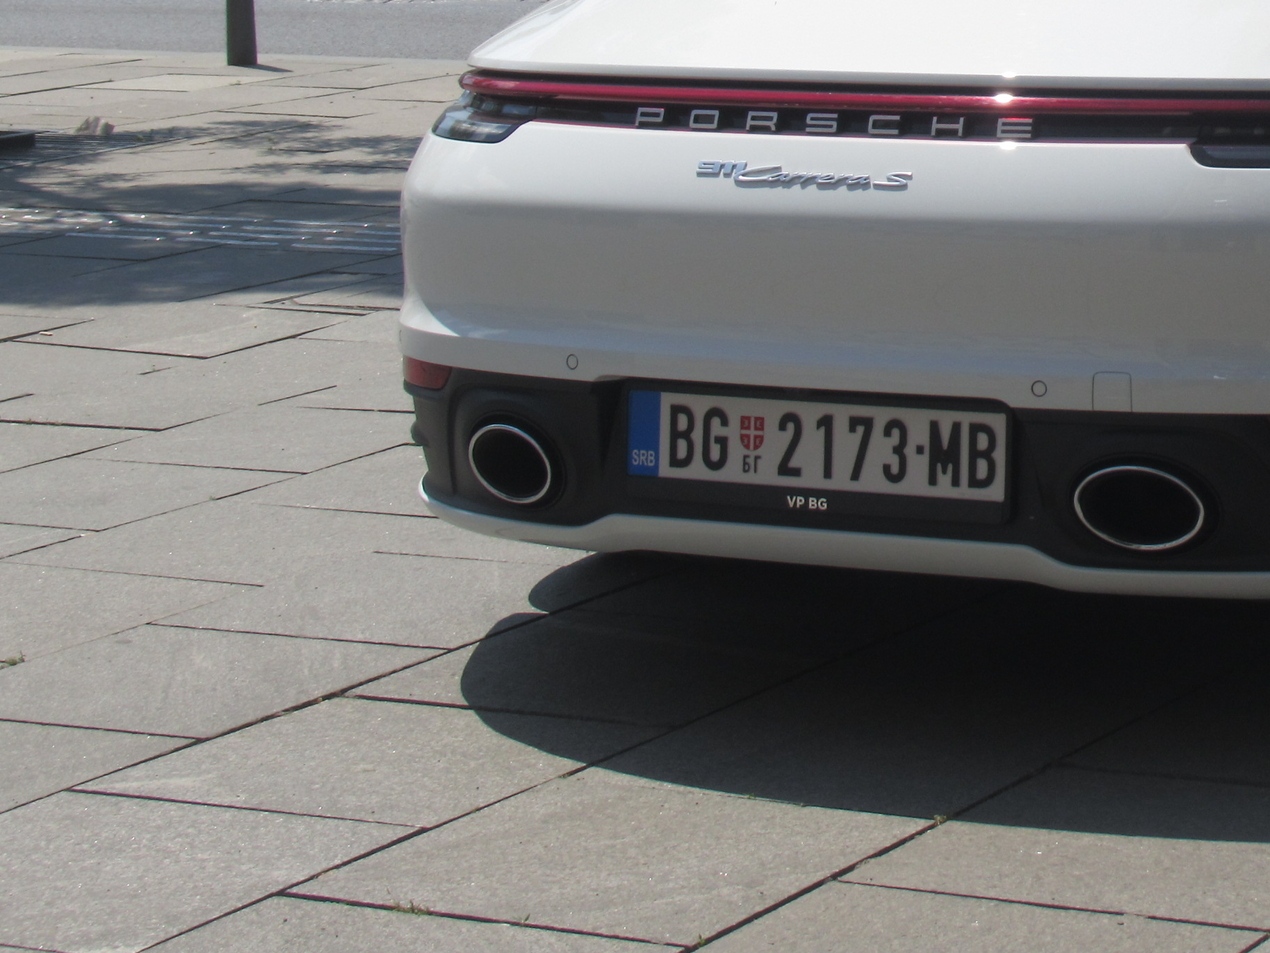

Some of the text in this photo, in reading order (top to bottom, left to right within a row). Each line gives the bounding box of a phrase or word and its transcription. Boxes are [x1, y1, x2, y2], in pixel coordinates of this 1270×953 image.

[635, 107, 1034, 139] PORSCHE
[696, 159, 913, 190] 911 Carrera S
[668, 403, 730, 472] BG
[631, 449, 656, 468] SRB
[786, 495, 828, 511] VP BG
